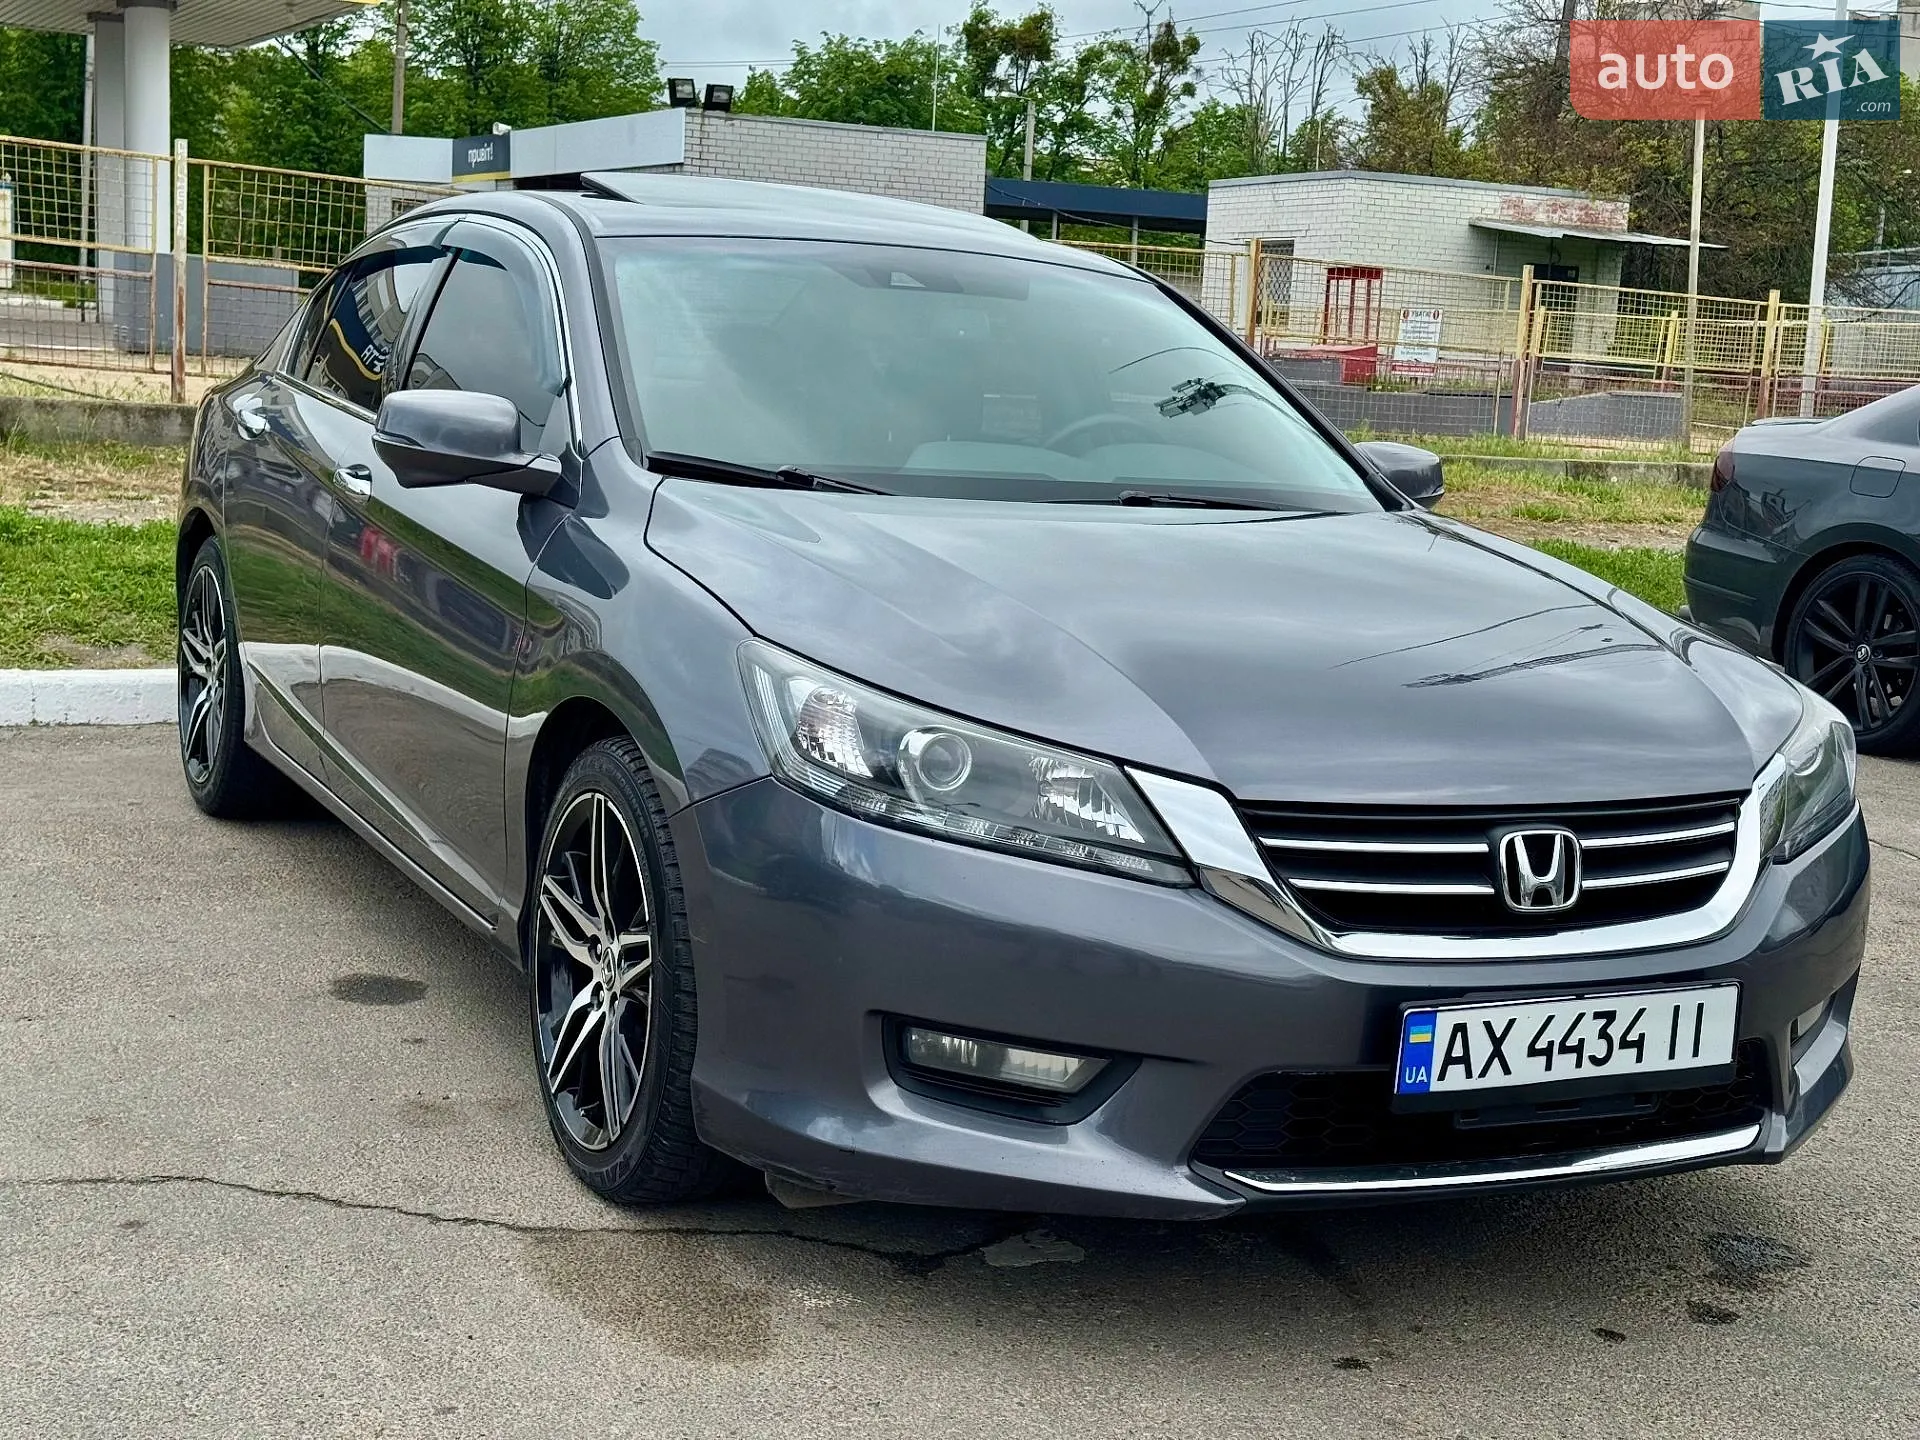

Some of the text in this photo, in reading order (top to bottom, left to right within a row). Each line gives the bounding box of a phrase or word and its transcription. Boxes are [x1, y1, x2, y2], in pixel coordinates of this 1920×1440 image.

[468, 142, 494, 168] привіт!
[1437, 1002, 1705, 1082] AX 4434 II
[1405, 1066, 1428, 1084] UA
